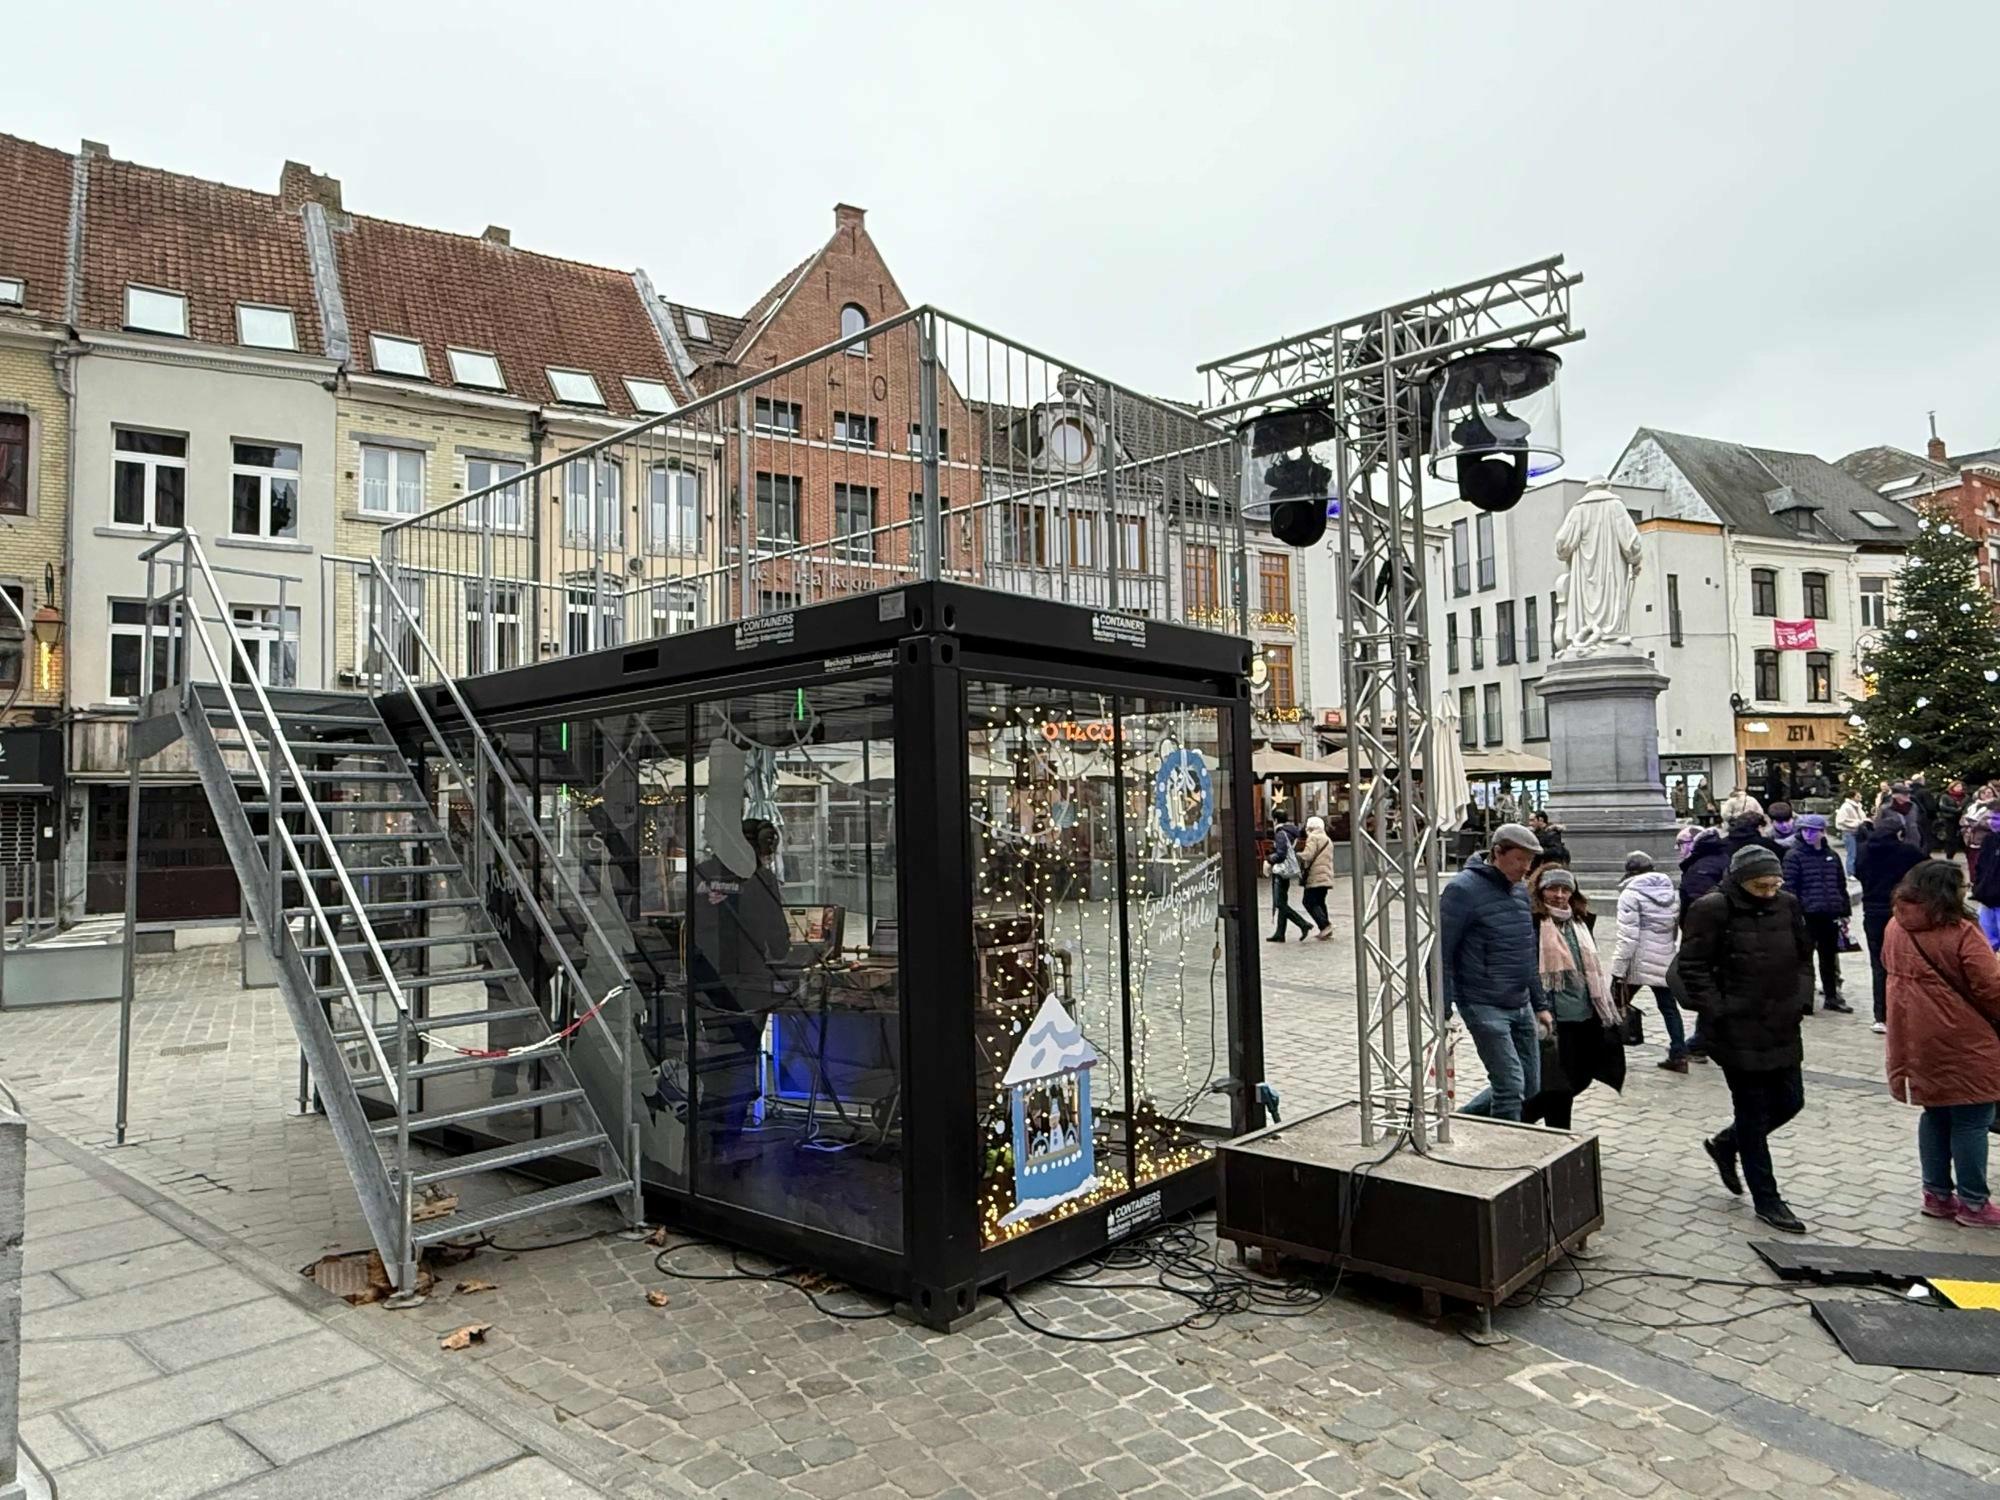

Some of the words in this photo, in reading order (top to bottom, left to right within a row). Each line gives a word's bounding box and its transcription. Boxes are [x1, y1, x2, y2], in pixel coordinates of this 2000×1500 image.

[743, 613, 794, 632] CONTAINERS
[1100, 614, 1146, 632] CONTAINERS
[853, 648, 893, 664] International
[1787, 725, 1815, 742] ZET'A
[1115, 1190, 1161, 1219] CONTAINERS
